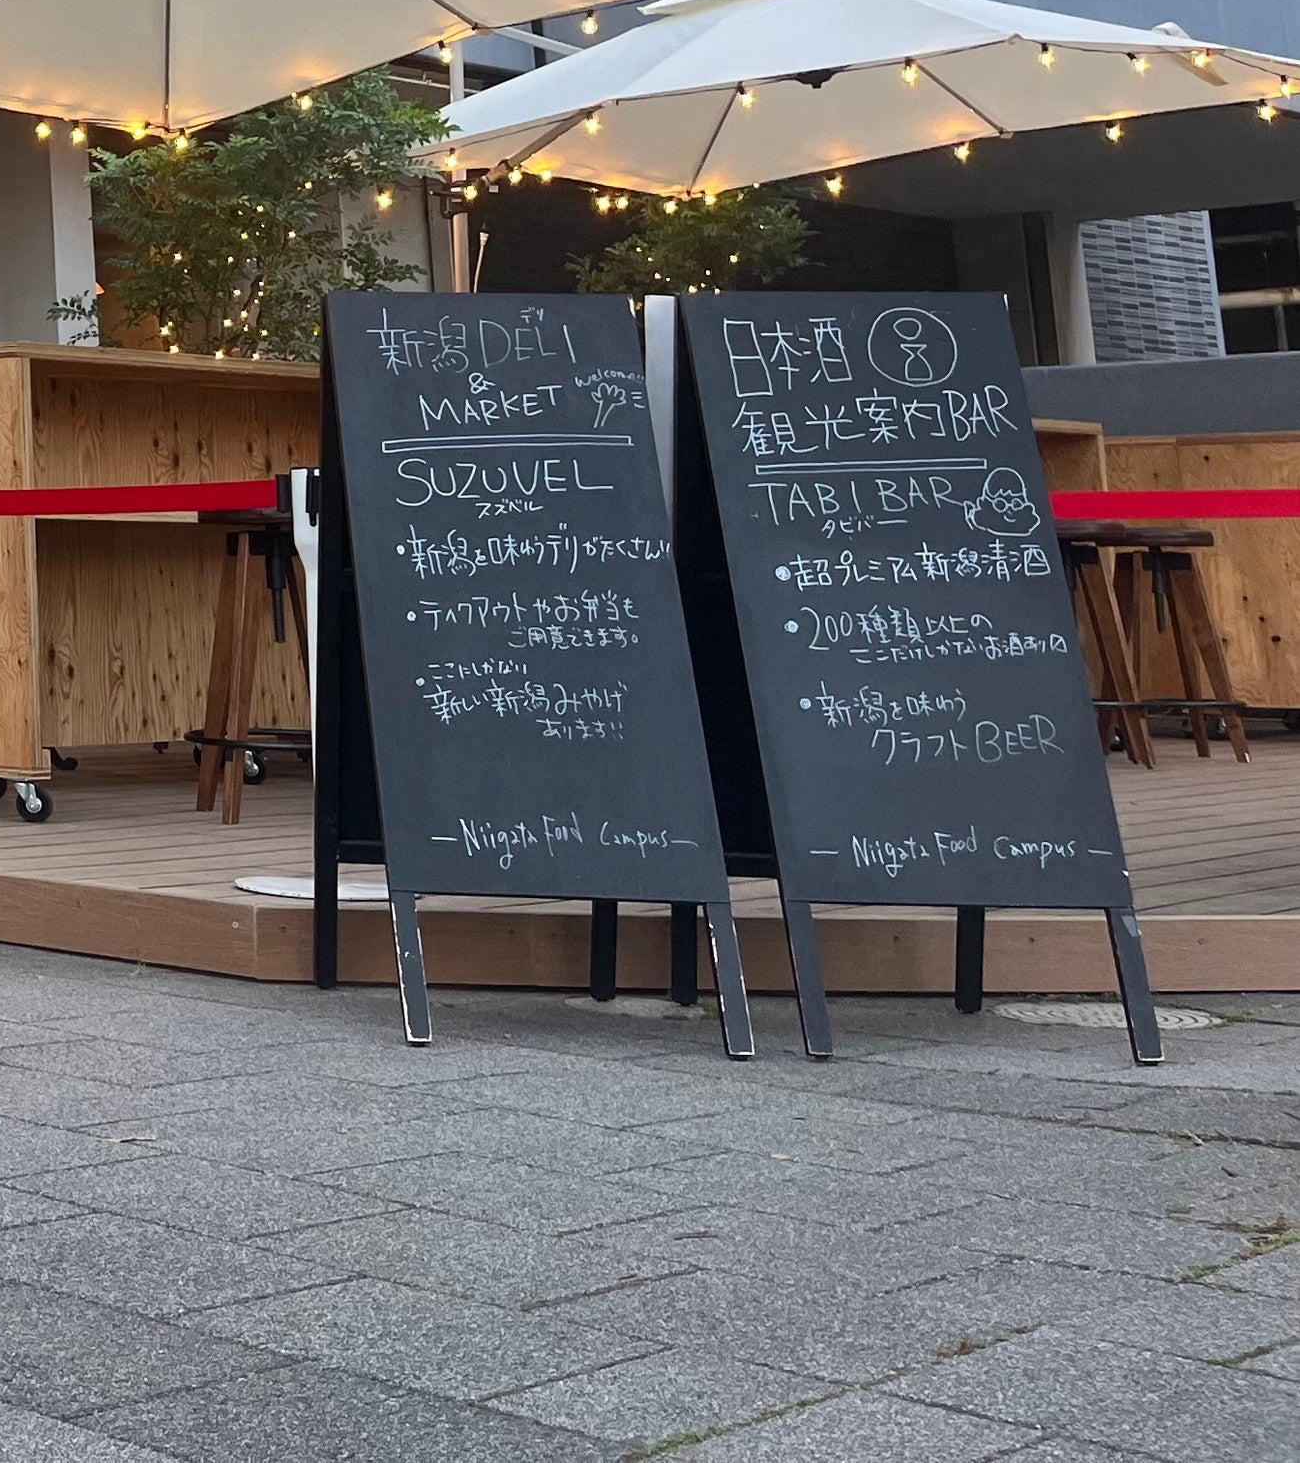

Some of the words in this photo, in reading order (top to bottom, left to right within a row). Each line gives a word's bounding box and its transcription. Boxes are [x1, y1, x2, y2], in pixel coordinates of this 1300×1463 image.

[723, 317, 853, 398] 日本酒
[419, 384, 563, 431] MARKET
[468, 372, 496, 395] &
[732, 384, 1018, 458] 観光案内BAR
[396, 458, 614, 507] SUZUVEL
[747, 480, 862, 526] TABI
[875, 476, 956, 514] BAR
[475, 499, 544, 519] スズベル
[821, 516, 908, 540] タビバー
[788, 539, 1052, 592] 超プレミアム新潟清酒
[423, 678, 628, 725] 新しい新潟みやげ
[815, 681, 967, 728] 新潟を味わう
[459, 817, 538, 870] Niigata
[542, 811, 584, 858] Food
[599, 821, 669, 859] Campus
[852, 835, 930, 879] Niigata
[933, 824, 978, 866] Food
[993, 835, 1076, 869] Campus
